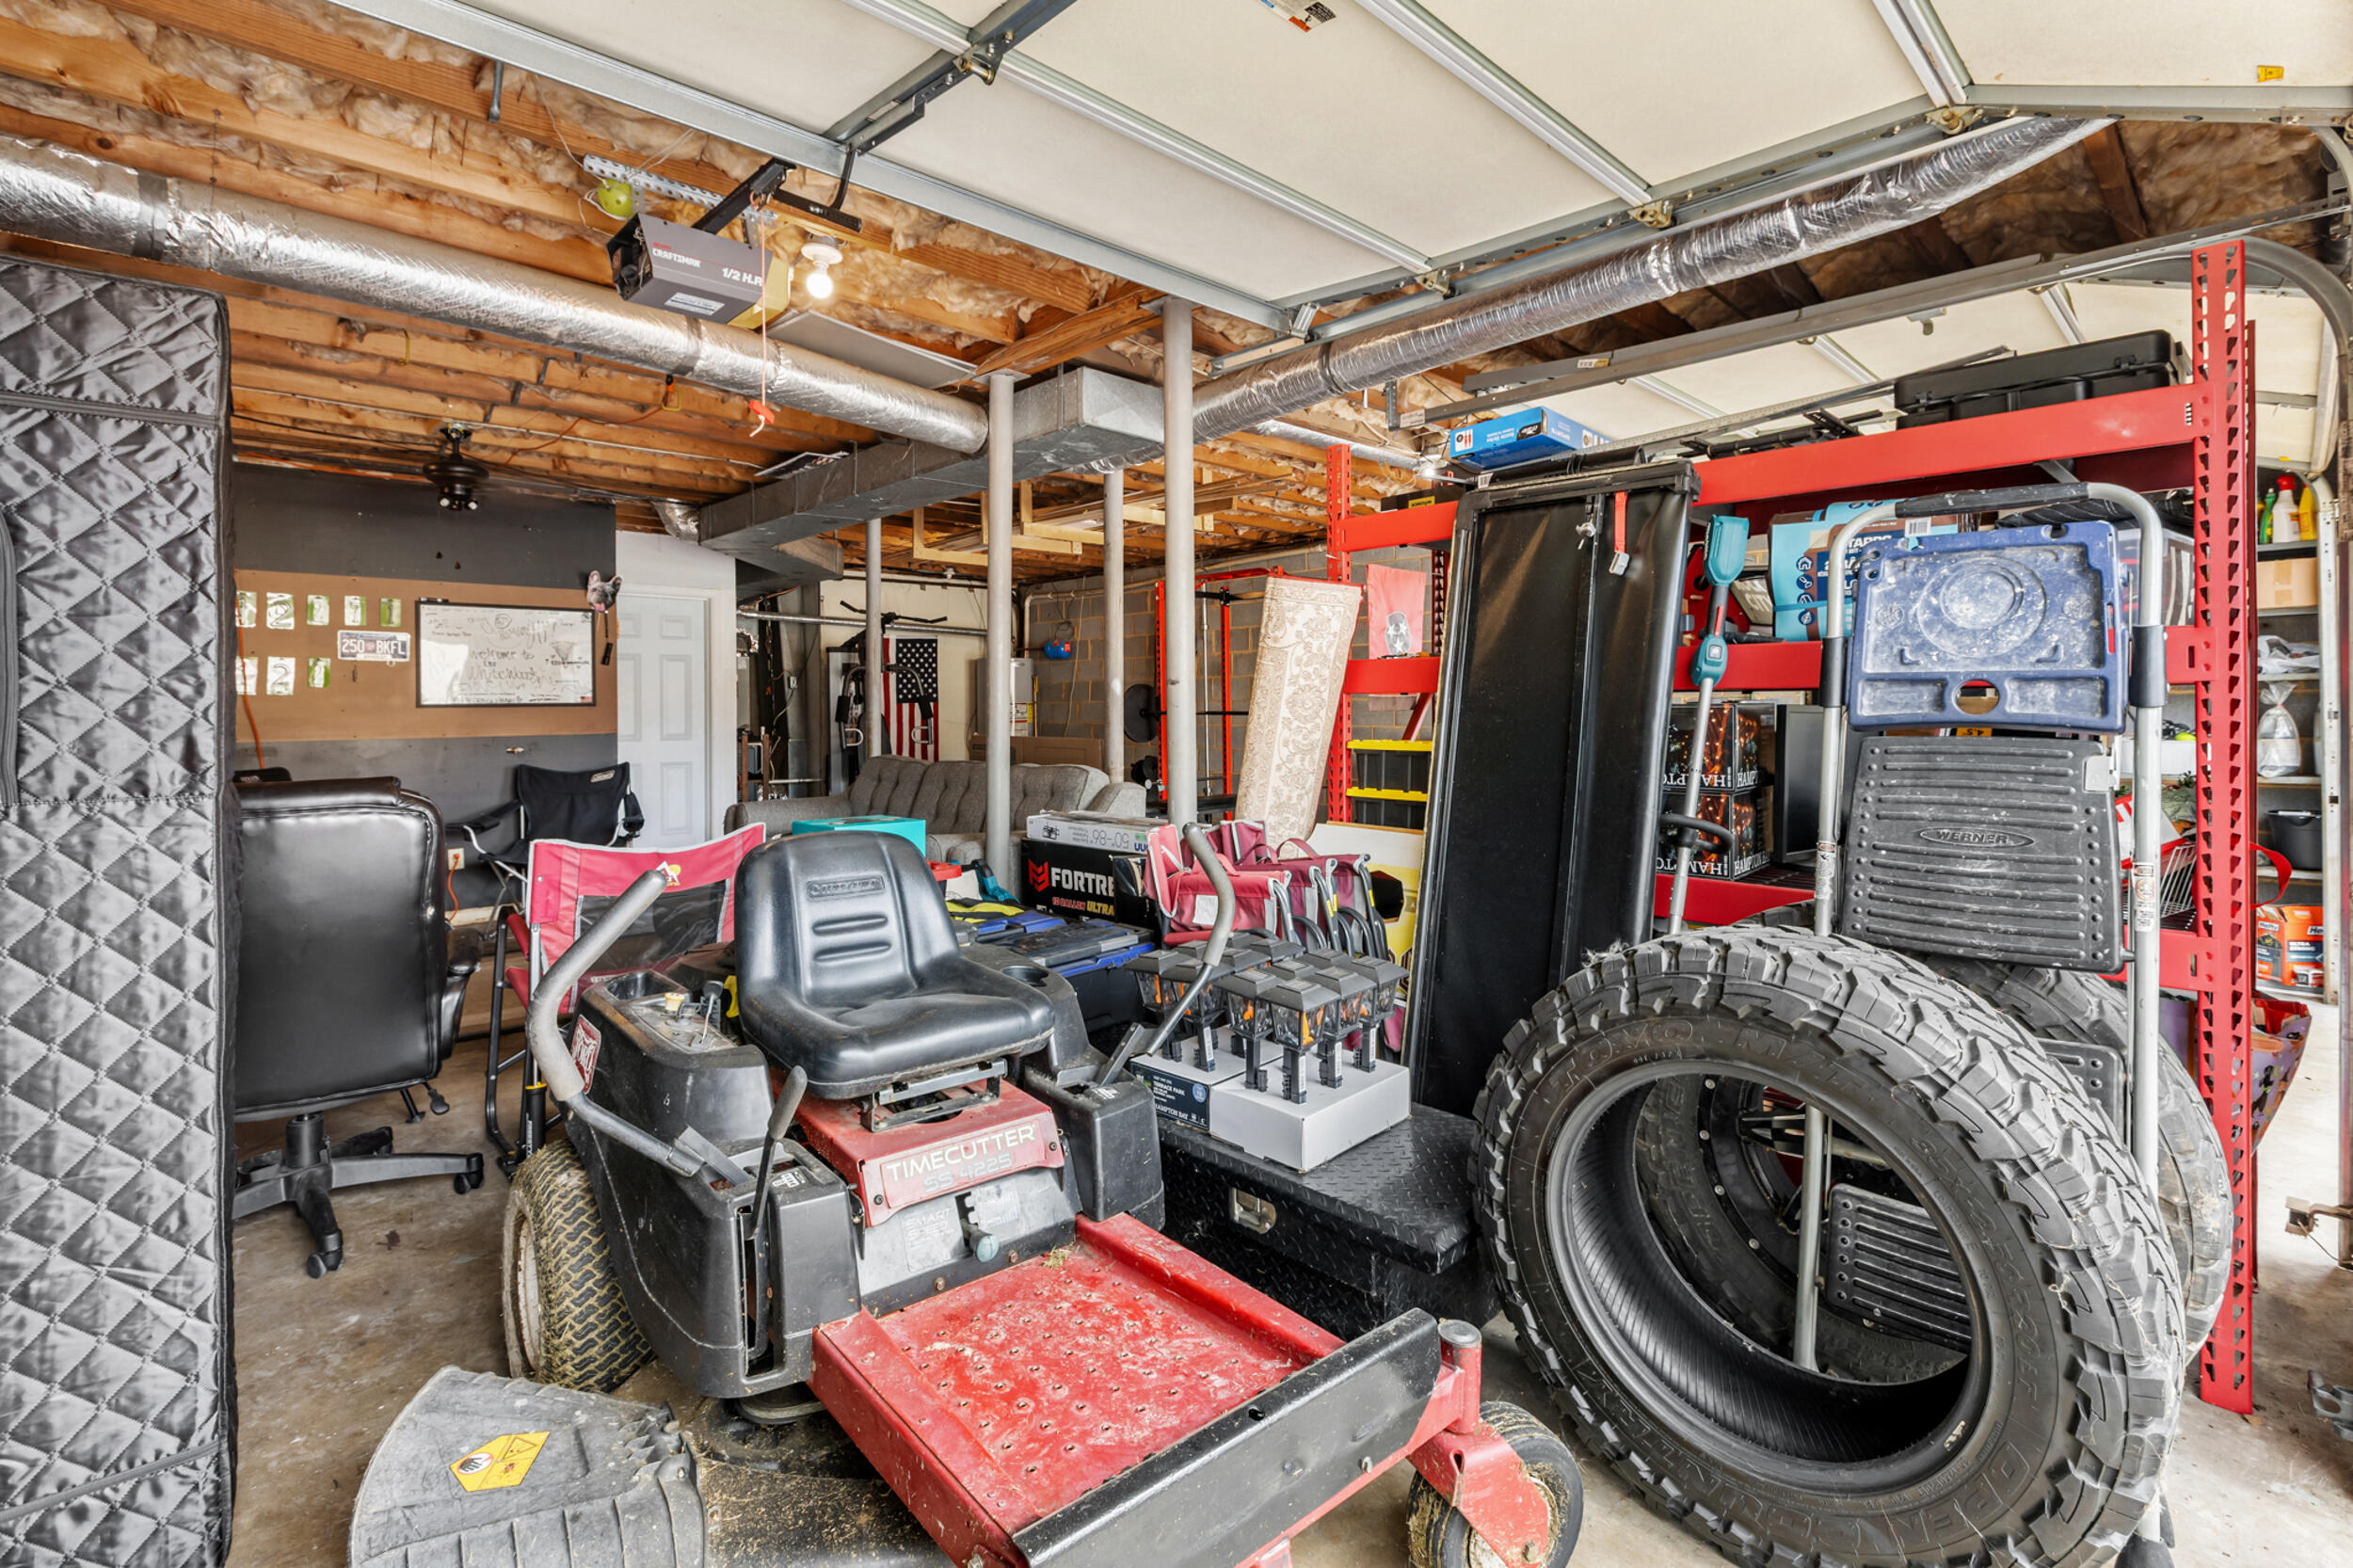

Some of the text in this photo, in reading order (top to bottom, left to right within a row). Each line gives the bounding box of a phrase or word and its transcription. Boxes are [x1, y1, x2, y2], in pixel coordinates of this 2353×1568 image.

[652, 248, 701, 268] CRAFTSMAN
[722, 267, 741, 281] 1/2
[342, 639, 406, 656] 250 BKFL
[272, 663, 292, 686] 2
[1935, 830, 2009, 845] WERNER
[1060, 898, 1086, 911] GALLON
[1086, 900, 1115, 917] ULTRA
[1548, 1018, 1694, 1096] TOYO
[886, 1124, 1036, 1183] TIMECUTTER
[923, 1151, 1014, 1193] SS 4225
